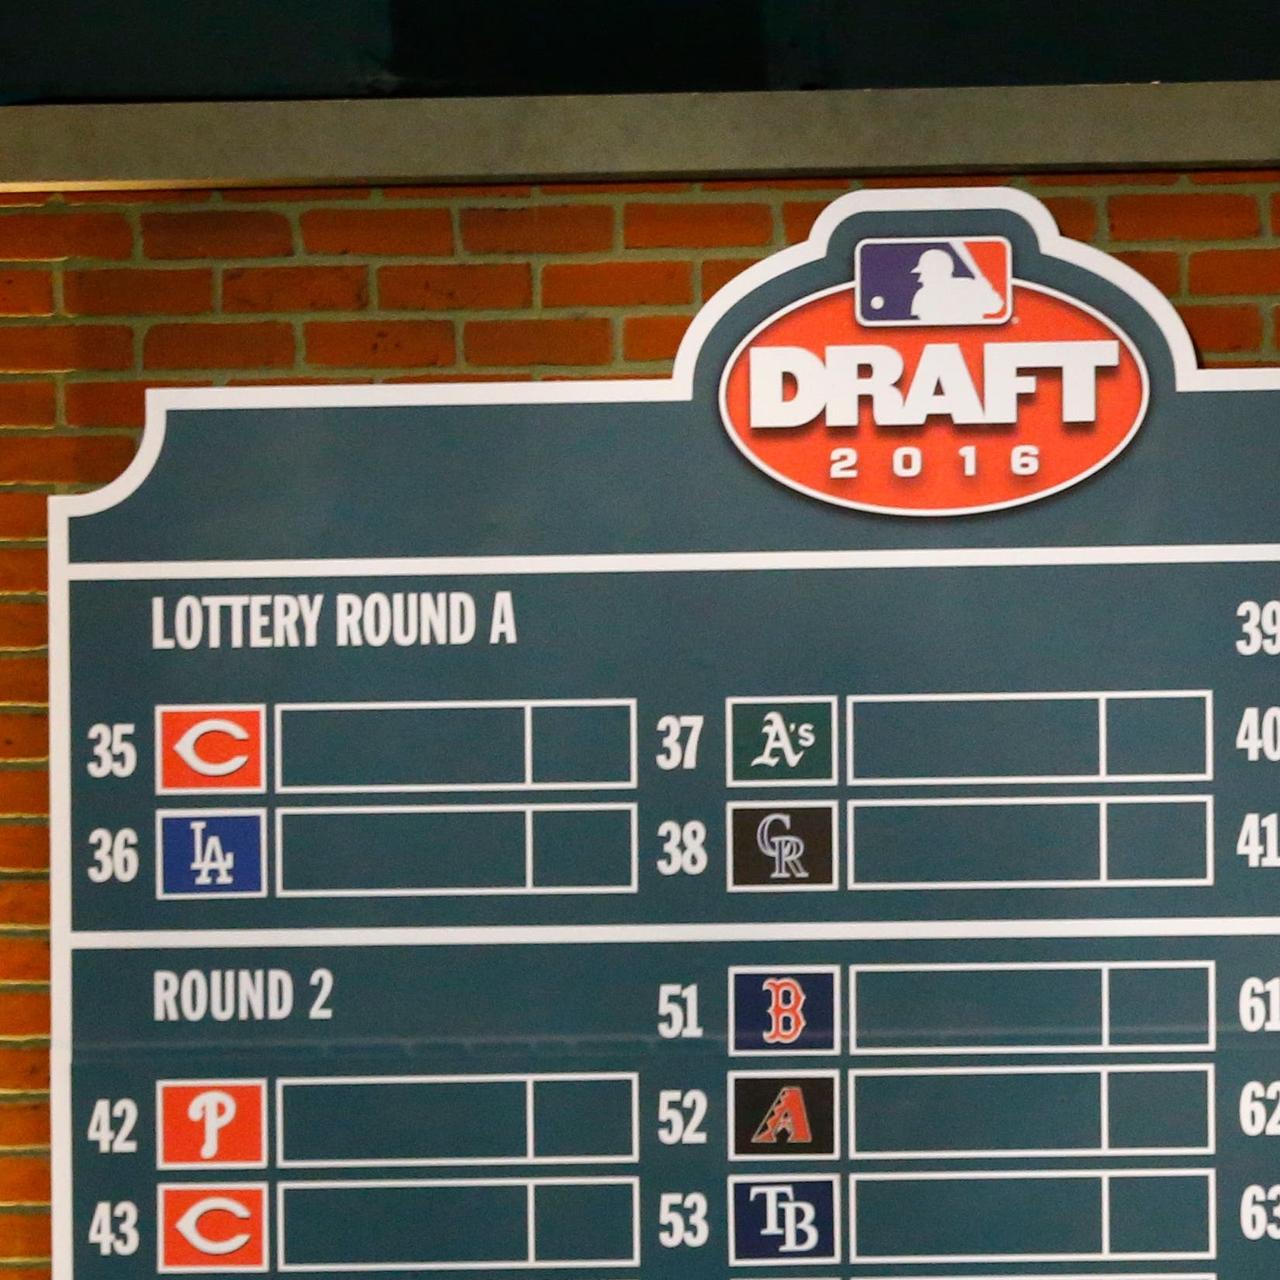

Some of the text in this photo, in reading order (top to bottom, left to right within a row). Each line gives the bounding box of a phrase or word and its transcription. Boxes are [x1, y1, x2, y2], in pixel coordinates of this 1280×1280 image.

[748, 340, 1120, 428] DRAFT
[830, 445, 1039, 478] 2016
[151, 591, 517, 650] LOTTERY ROUND A
[87, 718, 249, 777] 35 C
[656, 715, 704, 770] 37
[88, 821, 234, 885] 36 LA
[657, 820, 707, 875] 38
[154, 968, 333, 1020] ROUND 2
[658, 977, 806, 1043] 51 B
[88, 1091, 236, 1160] 42 P
[658, 1087, 812, 1144] 52 A
[89, 1197, 251, 1256] 43 C
[659, 1185, 818, 1252] 53 TB
